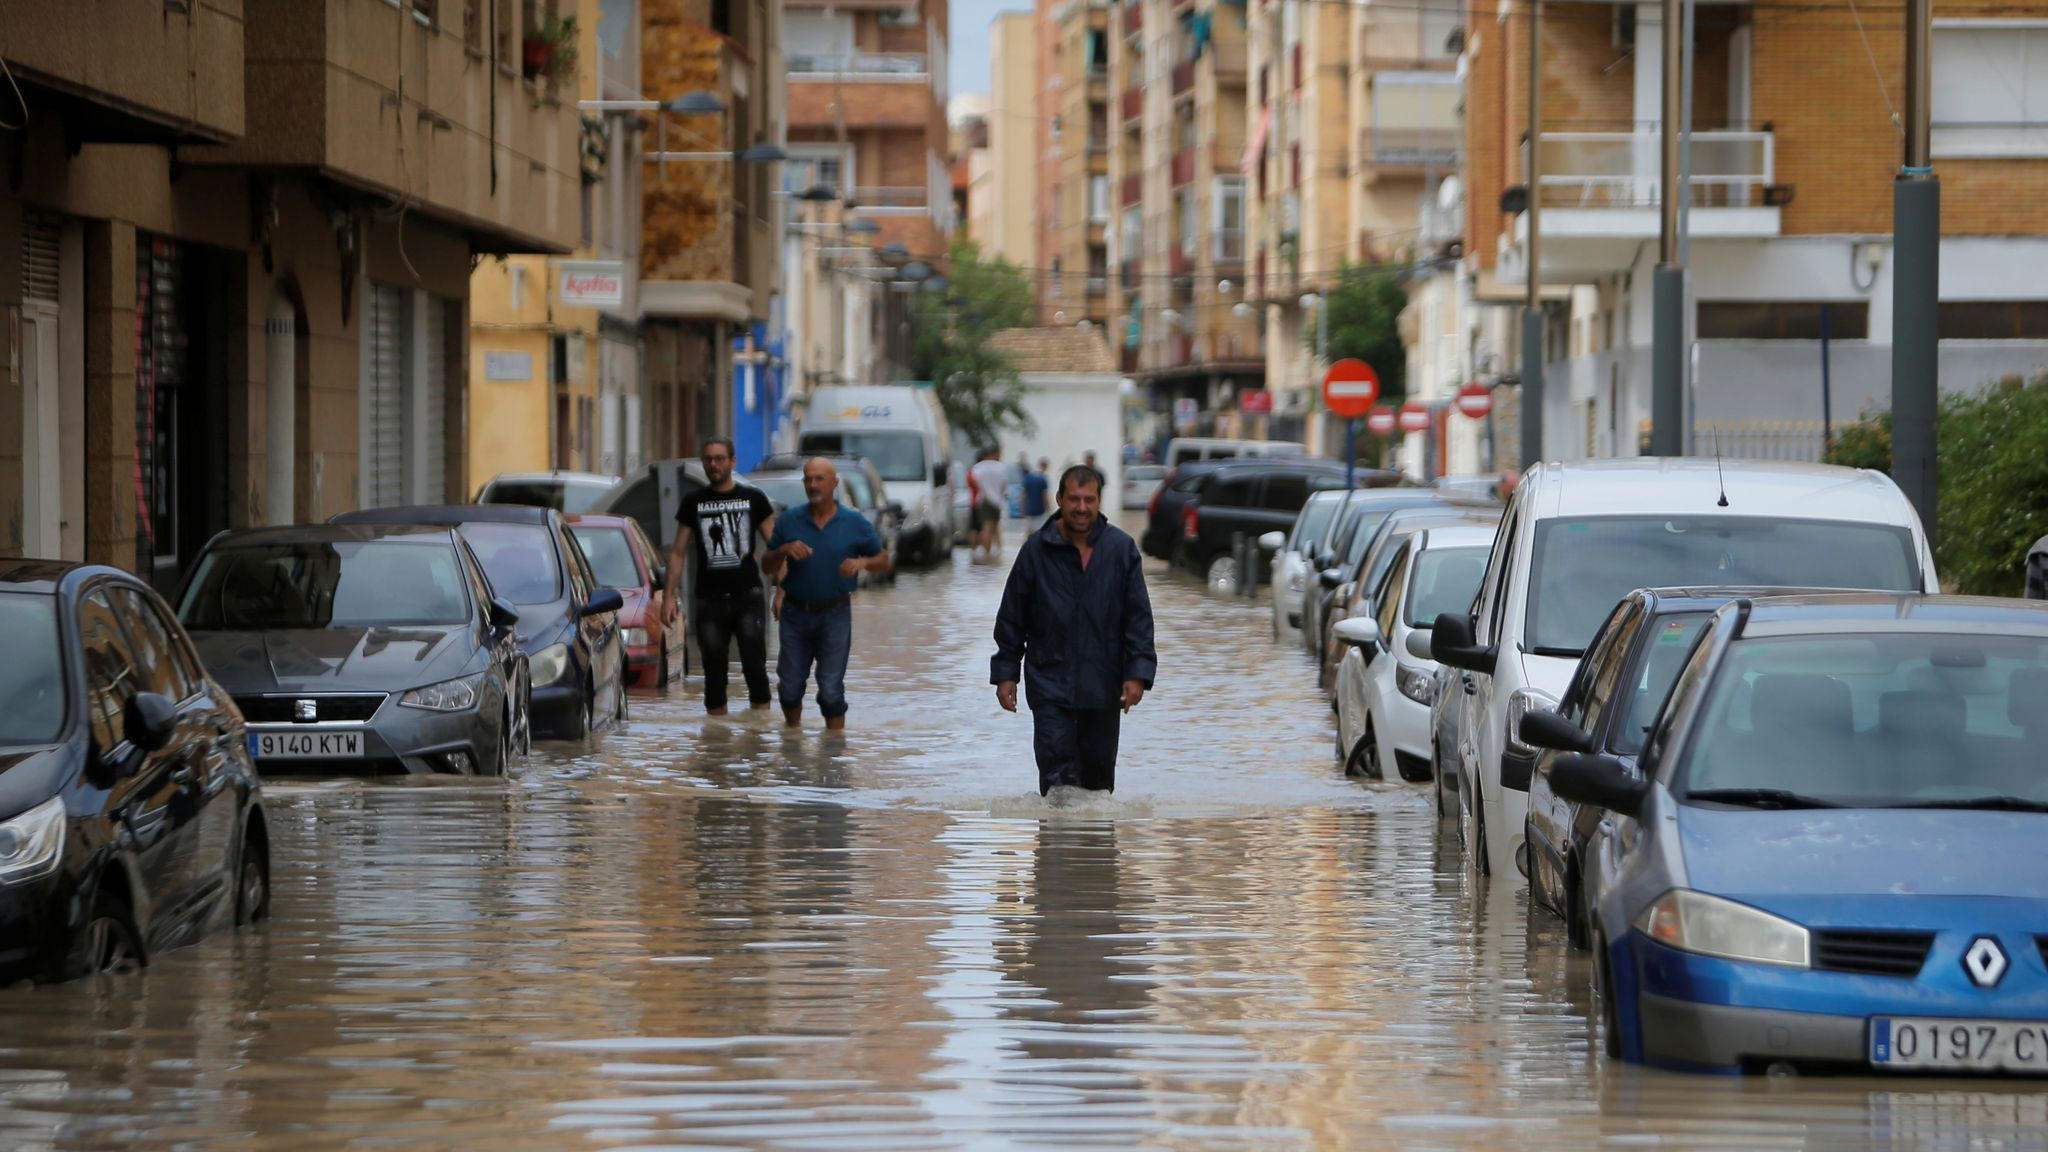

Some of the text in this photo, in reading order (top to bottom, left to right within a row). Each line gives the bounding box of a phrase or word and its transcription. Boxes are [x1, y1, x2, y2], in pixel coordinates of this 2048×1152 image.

[861, 405, 892, 418] GLS
[697, 500, 751, 512] HALLOWEEN
[262, 734, 357, 754] 9140 KTW
[1897, 1024, 1997, 1060] 0197
